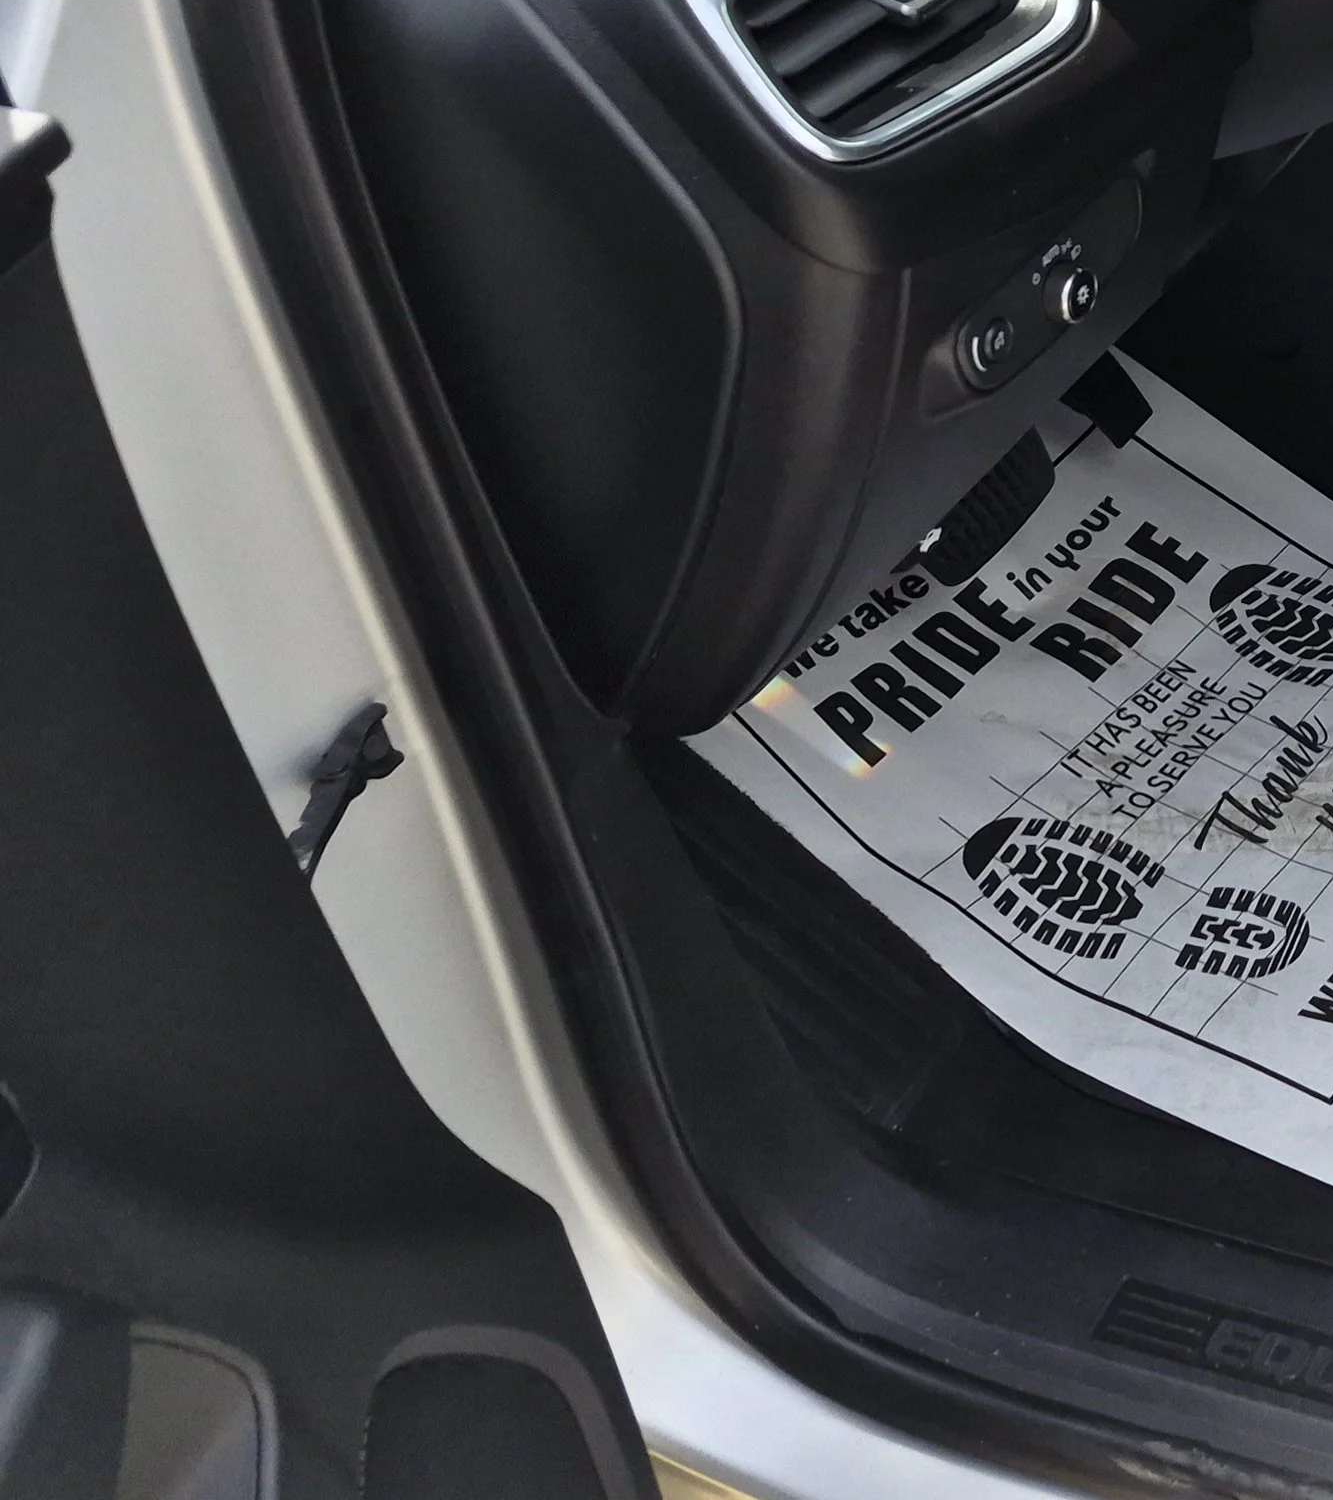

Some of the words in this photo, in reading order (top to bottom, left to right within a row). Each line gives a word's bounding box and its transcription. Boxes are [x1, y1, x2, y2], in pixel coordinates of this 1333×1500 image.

[812, 576, 1037, 768] PRIDE
[1006, 567, 1053, 601] in
[1044, 495, 1122, 572] your
[837, 574, 930, 639] take
[1029, 520, 1210, 683] RIDE
[1060, 748, 1094, 779] IT
[1084, 706, 1142, 756] HAS
[1131, 659, 1197, 714] BEEN
[1095, 778, 1124, 799] A
[1110, 676, 1228, 780] PLEASURE
[1110, 791, 1156, 821] TO
[1147, 723, 1225, 794] SERVE
[1211, 681, 1268, 726] YOU
[1193, 714, 1328, 851] Thank
